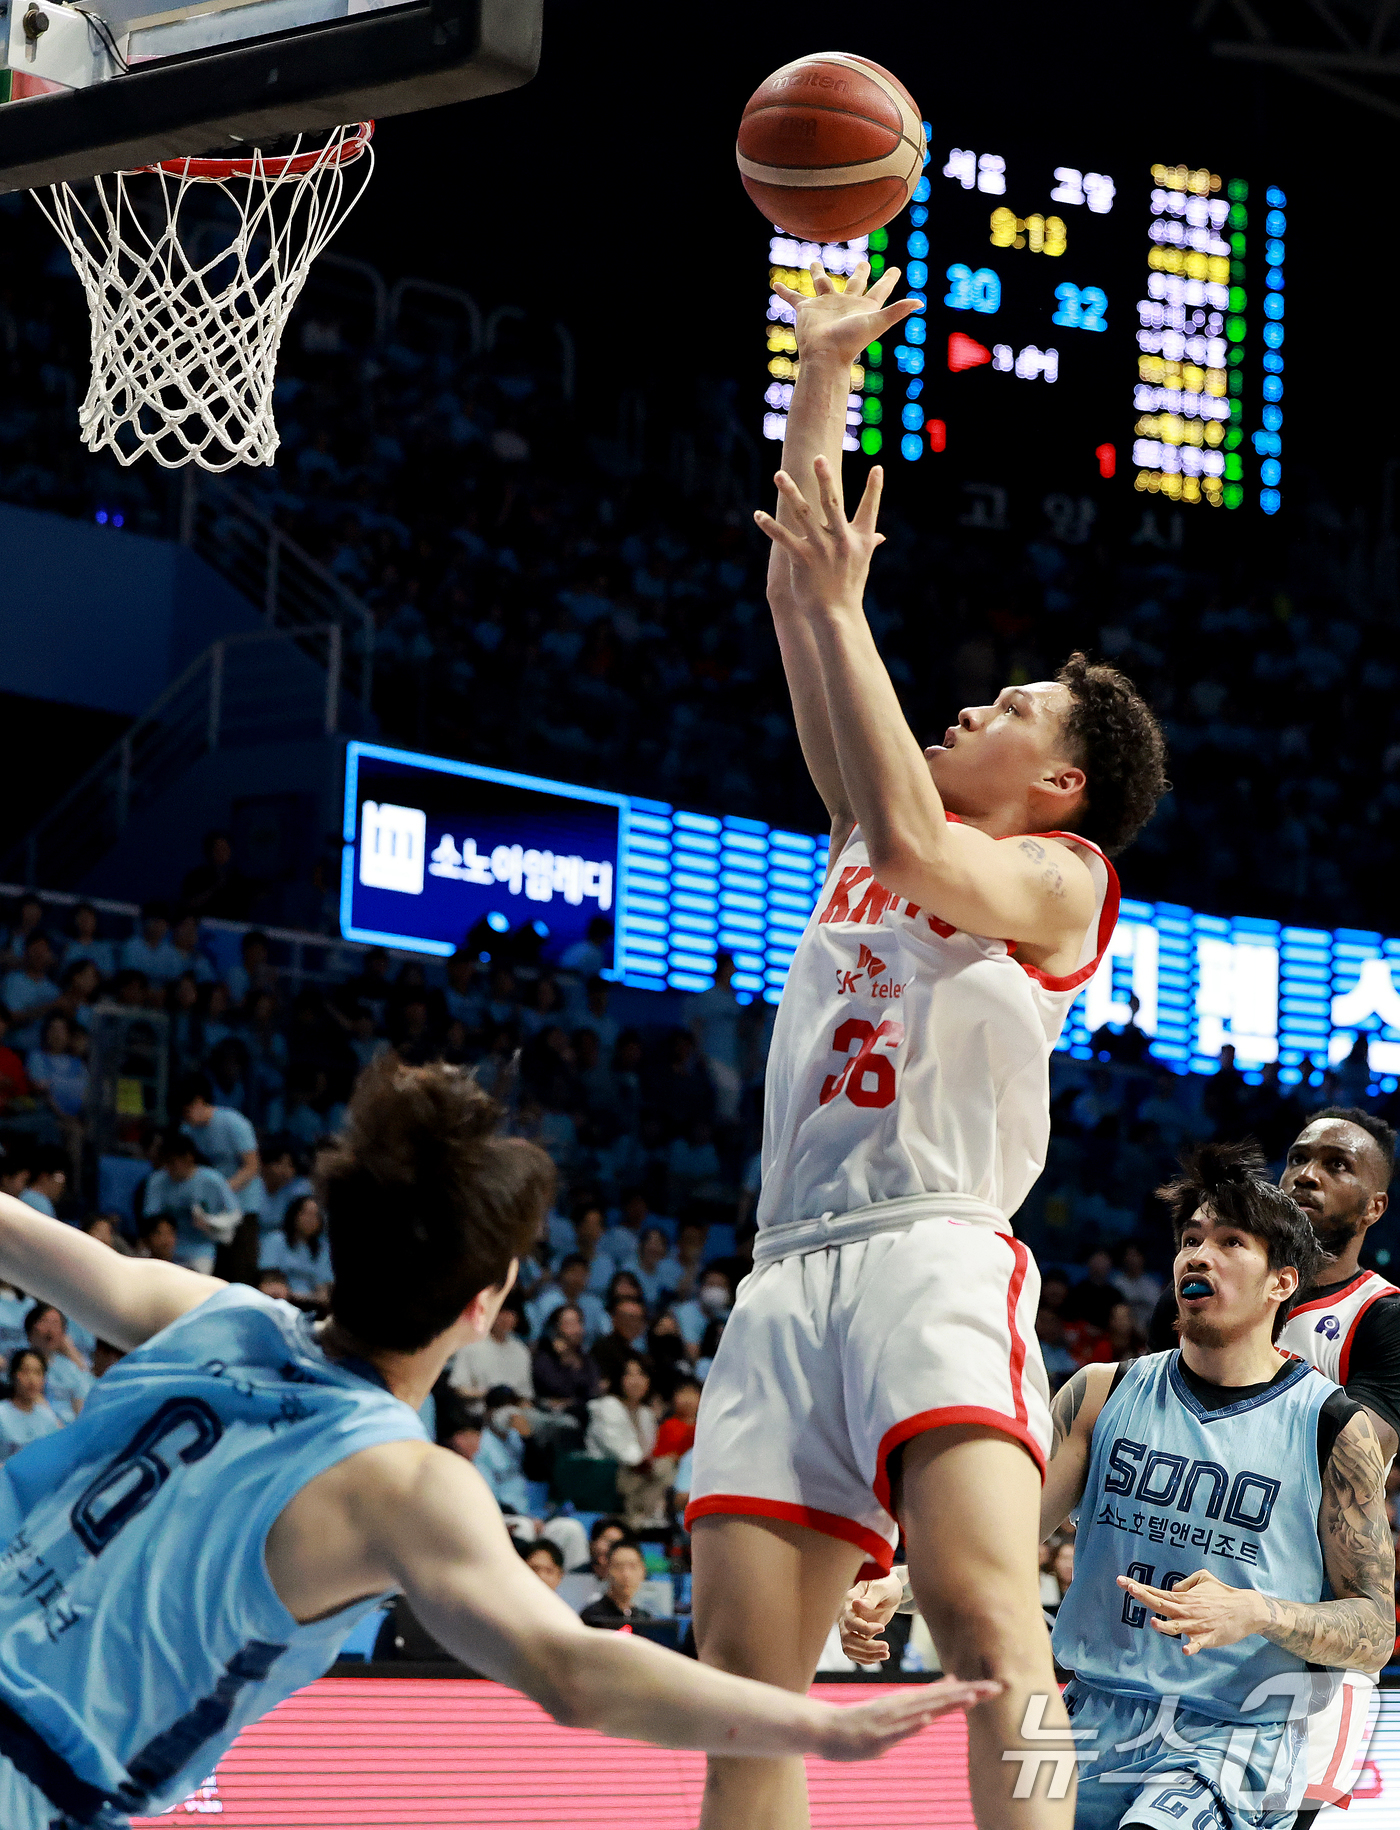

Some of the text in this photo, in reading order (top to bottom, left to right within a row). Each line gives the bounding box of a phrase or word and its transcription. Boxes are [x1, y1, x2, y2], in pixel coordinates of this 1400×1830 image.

[772, 72, 850, 92] molten
[944, 263, 1001, 314] 30
[1052, 282, 1108, 332] 32
[1096, 1503, 1259, 1567] 소노호텔앤리조트
